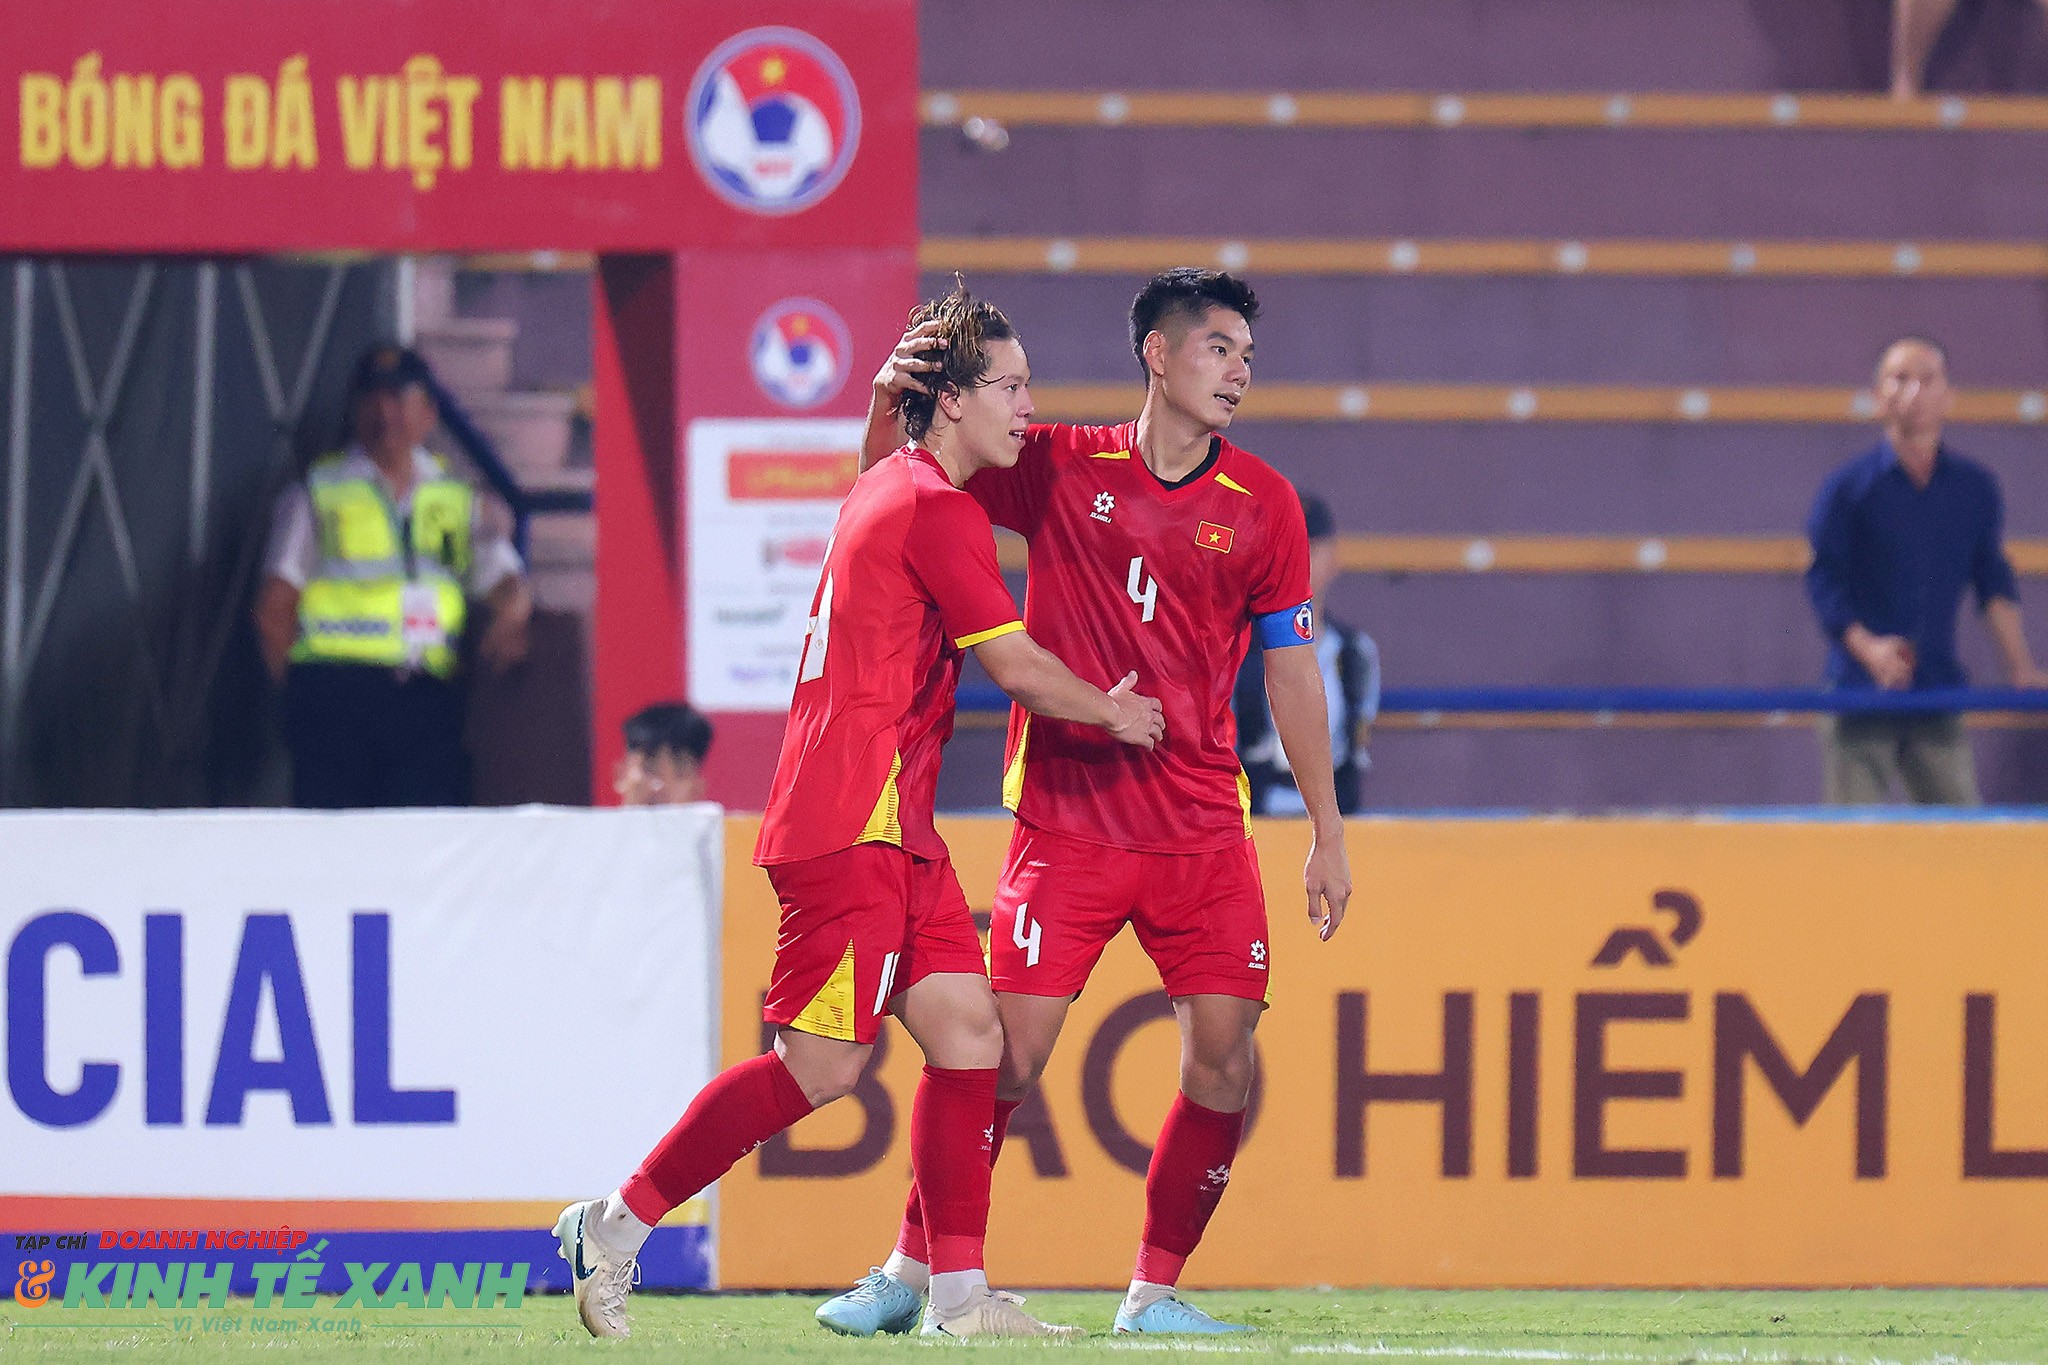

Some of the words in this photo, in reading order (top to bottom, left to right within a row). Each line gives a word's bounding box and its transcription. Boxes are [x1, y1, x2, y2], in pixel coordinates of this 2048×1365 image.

[20, 53, 204, 170] BÓNG
[222, 56, 318, 170] ĐÁ
[338, 55, 481, 190] VIỆT
[500, 76, 663, 170] NAM
[1127, 556, 1158, 623] 4
[1012, 902, 1042, 967] 4
[6, 910, 458, 1130] CIAL
[1334, 886, 1890, 1180] HIỂM
